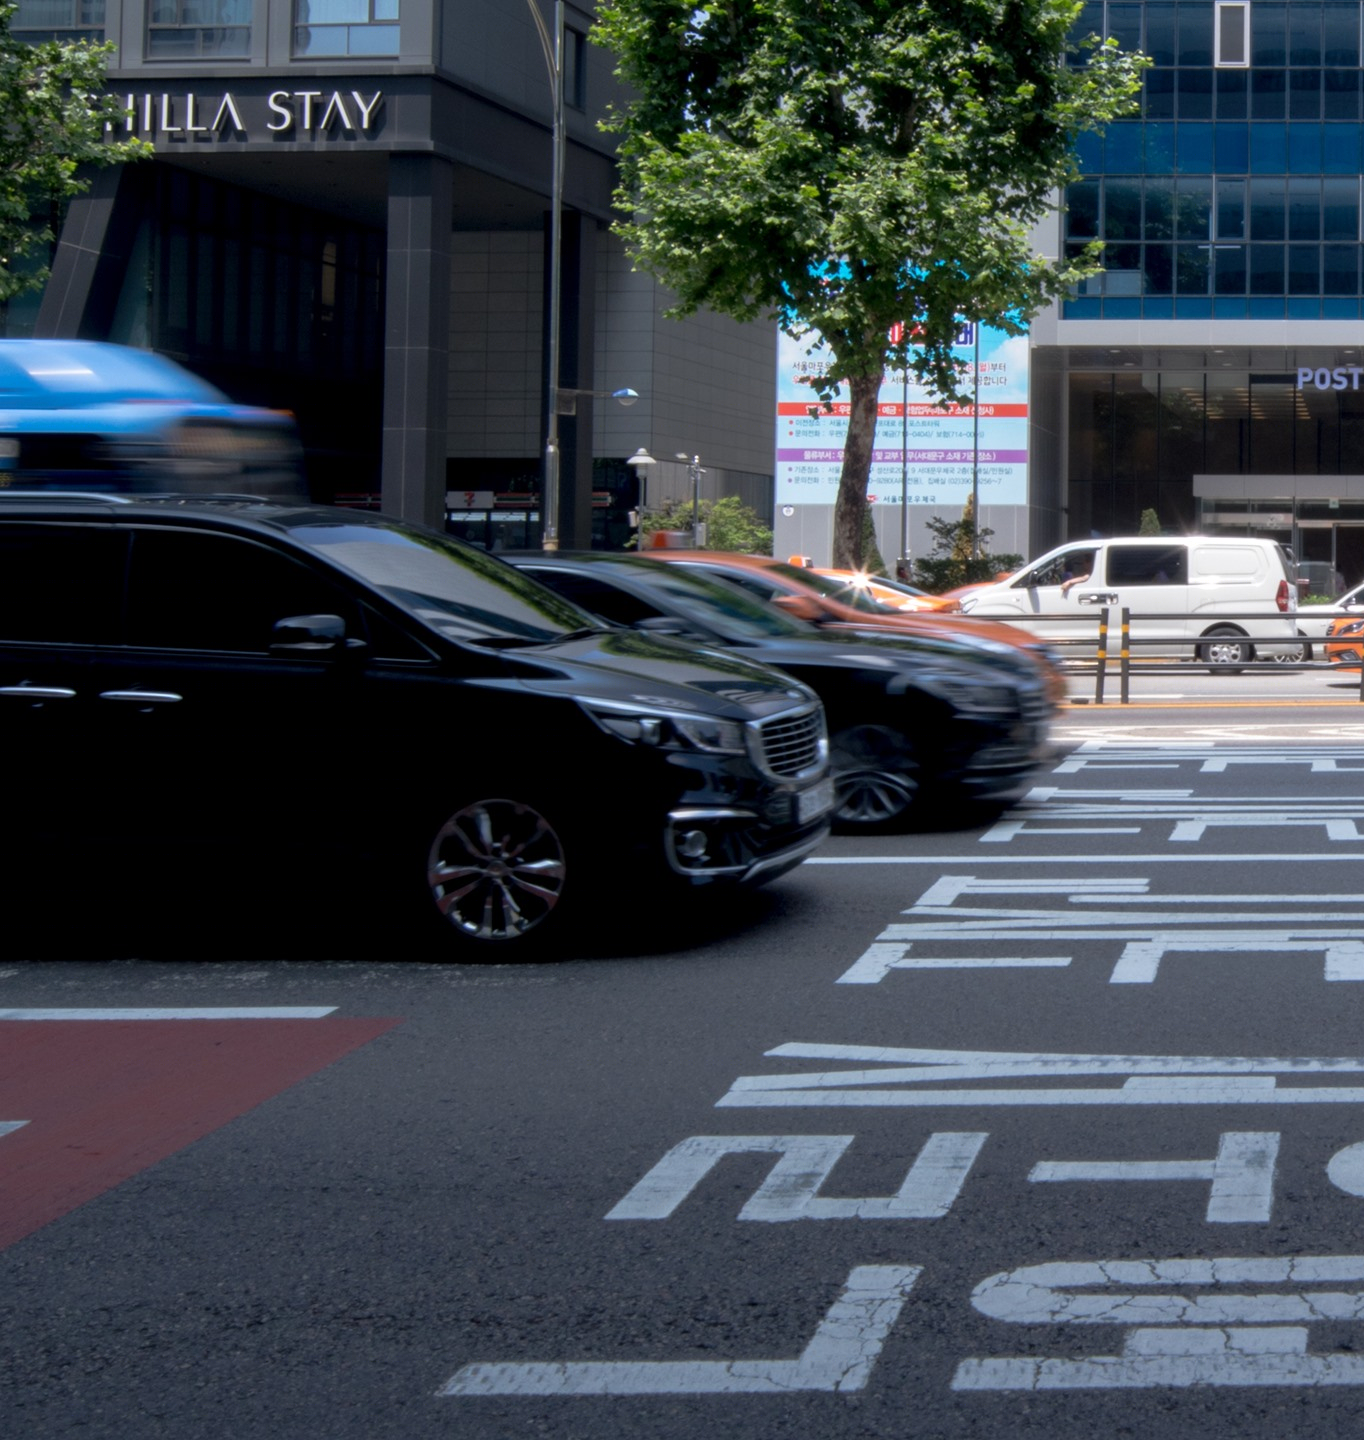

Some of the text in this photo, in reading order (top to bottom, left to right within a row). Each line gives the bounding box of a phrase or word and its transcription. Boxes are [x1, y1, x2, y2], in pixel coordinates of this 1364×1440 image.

[86, 91, 382, 131] HILLA STAY
[1297, 367, 1364, 390] POST
